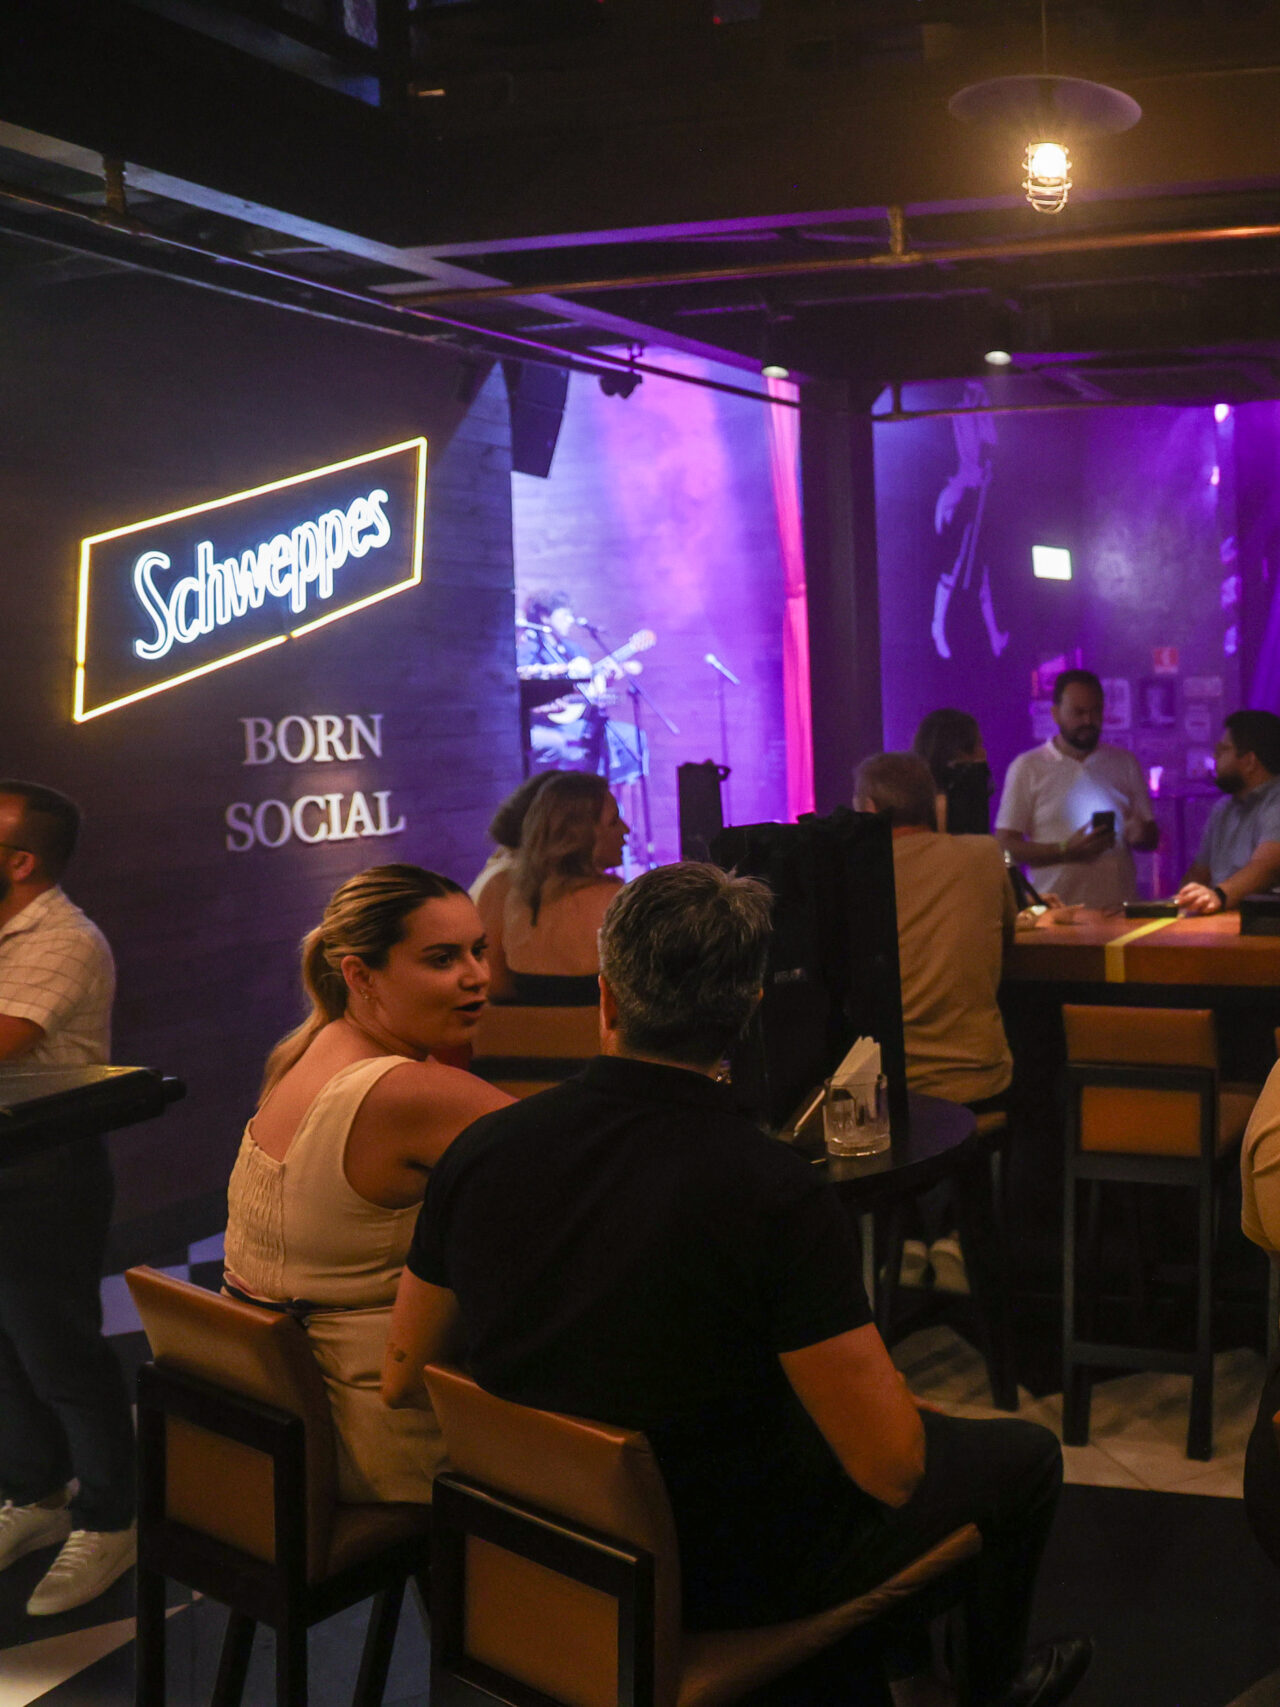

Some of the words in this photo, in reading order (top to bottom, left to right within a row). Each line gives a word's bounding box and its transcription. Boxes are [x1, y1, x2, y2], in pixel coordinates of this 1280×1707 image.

[133, 489, 391, 660] Schweppes
[239, 714, 384, 765] BORN
[225, 790, 406, 852] SOCIAL
